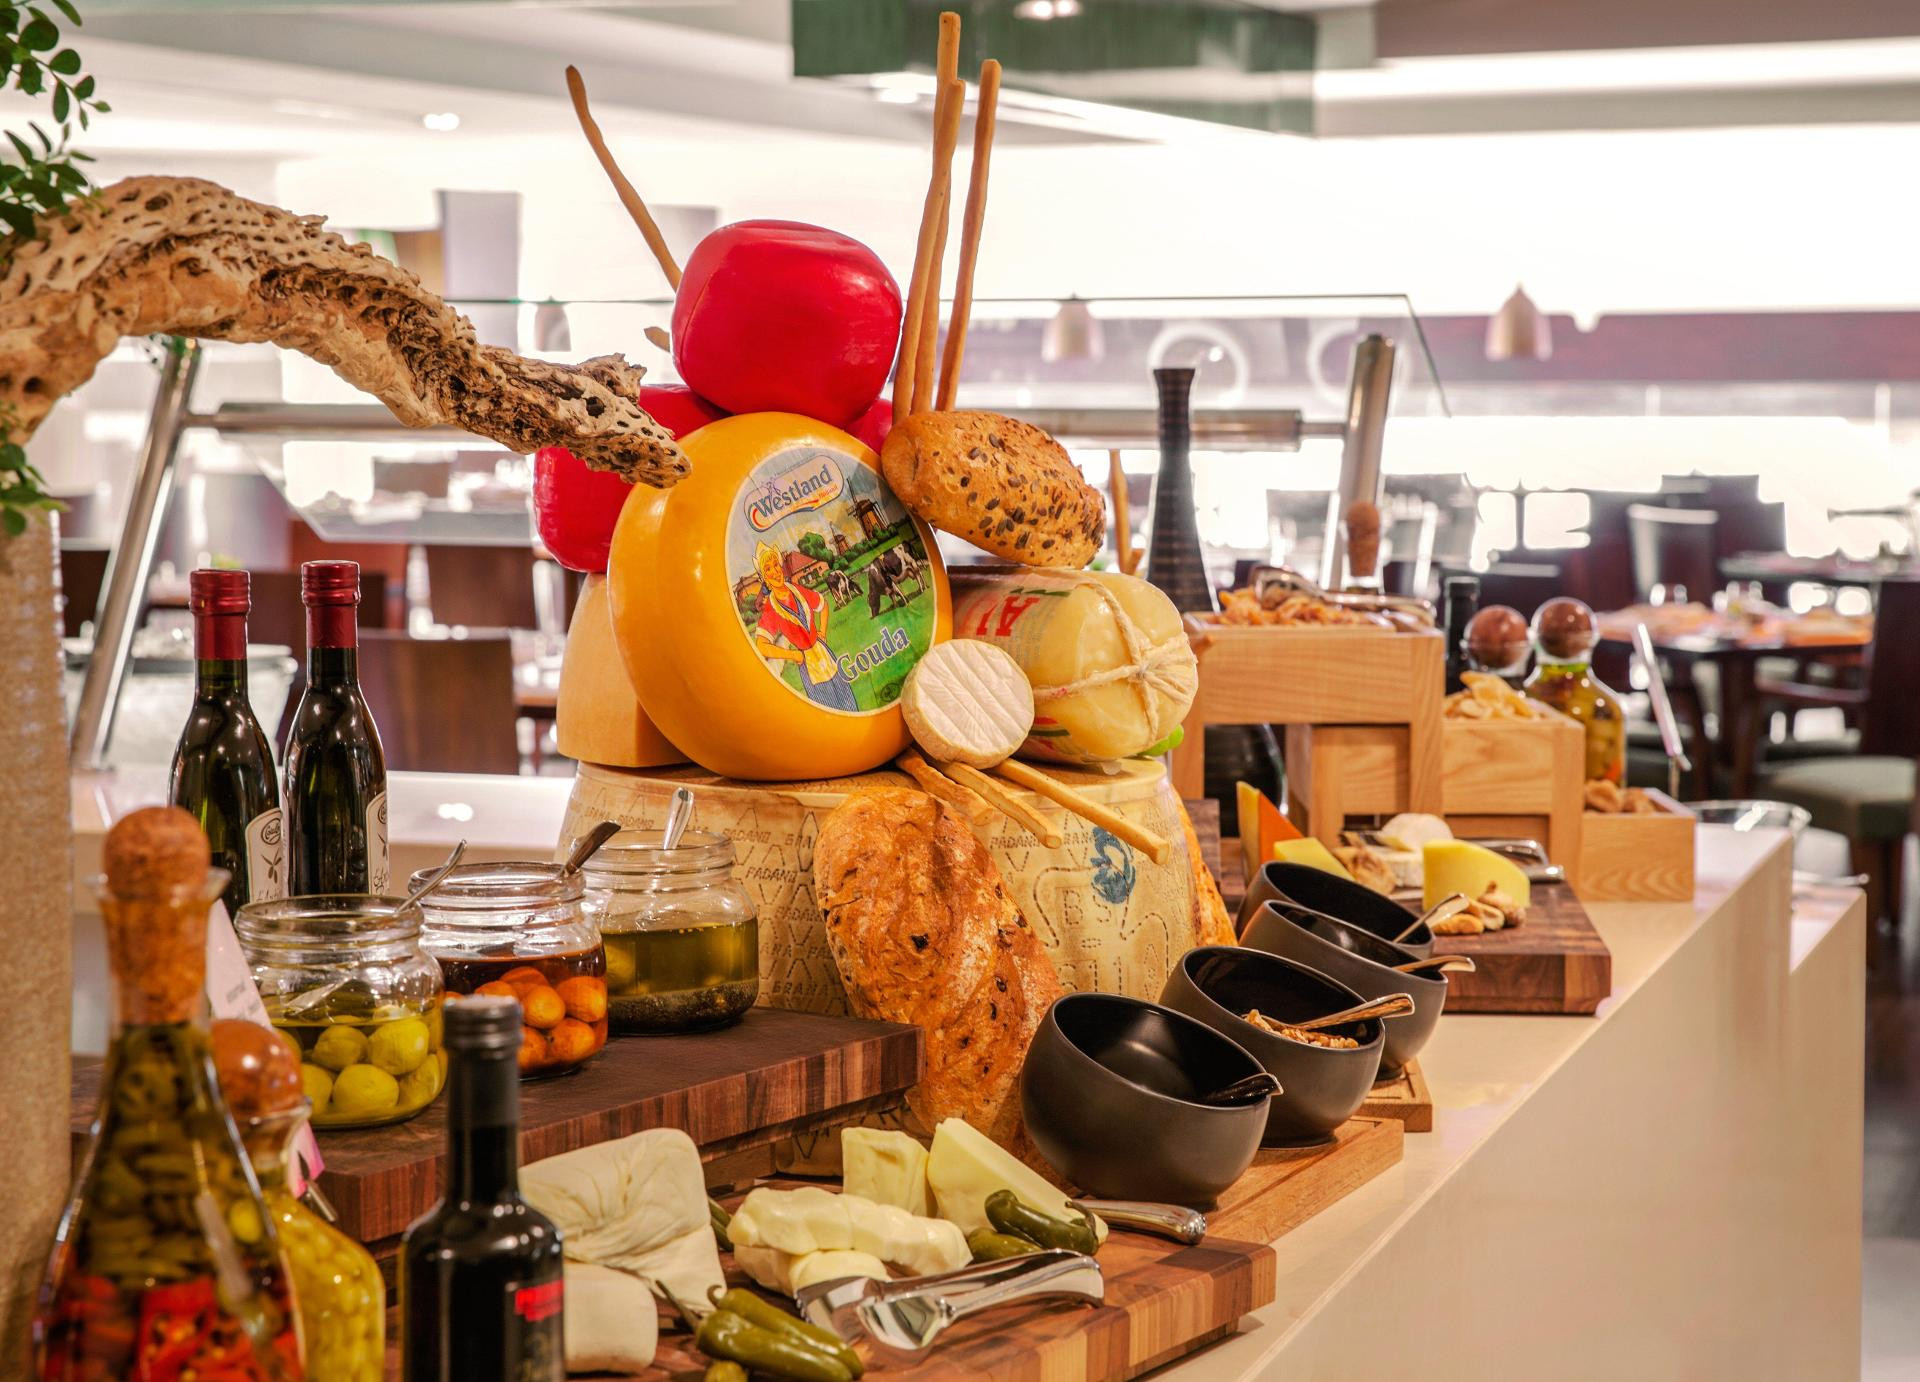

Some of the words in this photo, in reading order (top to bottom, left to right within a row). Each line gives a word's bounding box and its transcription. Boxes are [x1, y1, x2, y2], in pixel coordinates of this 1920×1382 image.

[751, 463, 833, 518] Westland
[837, 626, 911, 683] Gouda
[745, 866, 800, 884] PADANO
